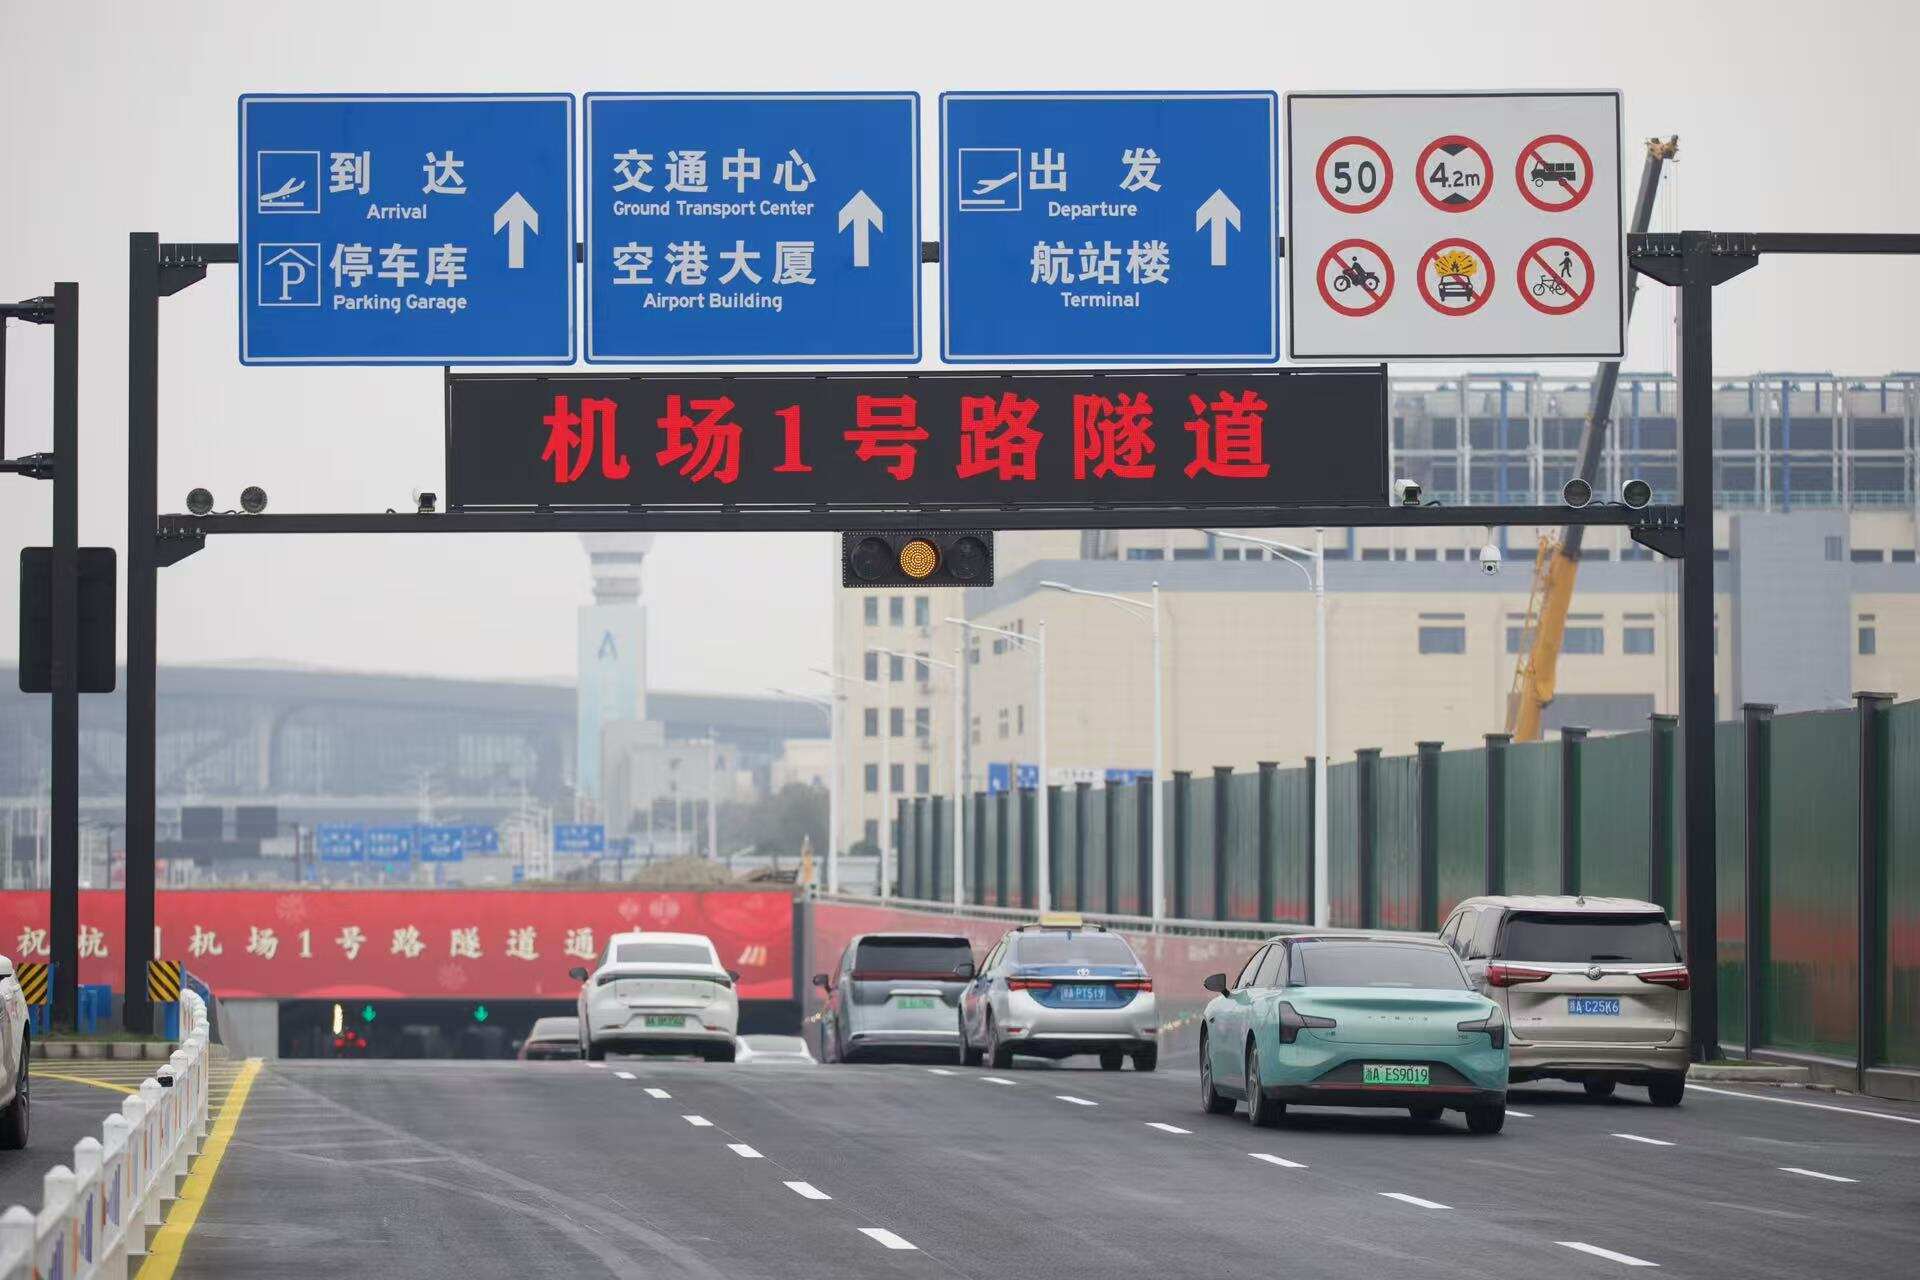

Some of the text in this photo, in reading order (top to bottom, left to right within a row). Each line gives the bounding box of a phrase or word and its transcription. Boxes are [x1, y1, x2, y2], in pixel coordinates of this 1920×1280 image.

[612, 148, 817, 194] 交通中心
[1334, 161, 1377, 194] 50
[1429, 162, 1481, 188] 4.2m
[366, 203, 427, 220] Arrival
[613, 200, 815, 219] Ground Transport Center
[1048, 201, 1138, 221] Departure
[329, 242, 468, 288] 停车库
[612, 240, 817, 286] 空港大厦
[1030, 239, 1170, 285] 航站楼
[279, 262, 306, 301] P
[333, 294, 468, 314] Parking Garage
[643, 292, 783, 313] Airport Building
[1060, 291, 1140, 308] Terminal
[541, 390, 1271, 484] 机场1号路隧道
